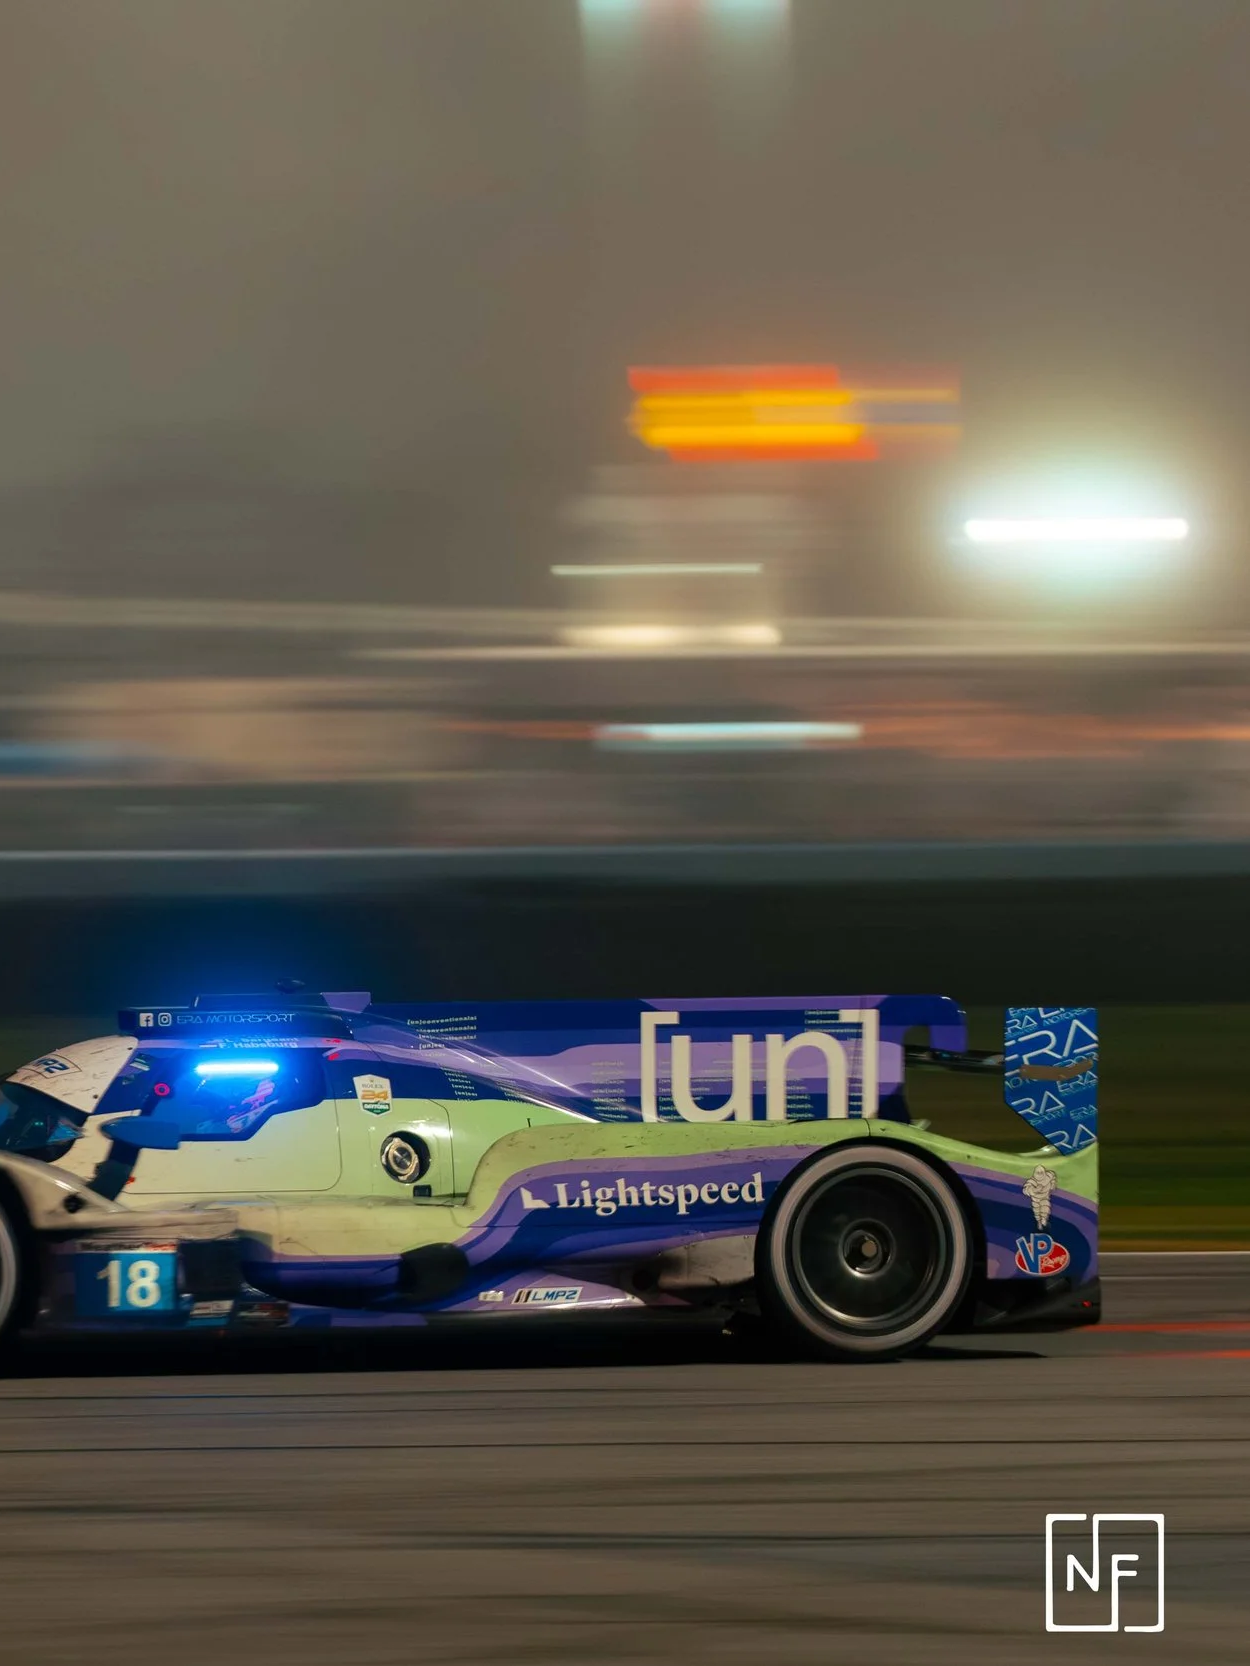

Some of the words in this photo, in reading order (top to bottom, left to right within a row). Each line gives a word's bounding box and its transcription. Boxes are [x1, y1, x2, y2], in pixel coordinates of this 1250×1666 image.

[176, 1015, 204, 1025] ERA
[206, 1013, 296, 1025] MOTORSPORT
[360, 1089, 389, 1101] 24
[554, 1172, 765, 1216] Lightspeed
[1015, 1233, 1053, 1275] VP
[96, 1259, 162, 1308] 18
[531, 1289, 579, 1302] LMP2
